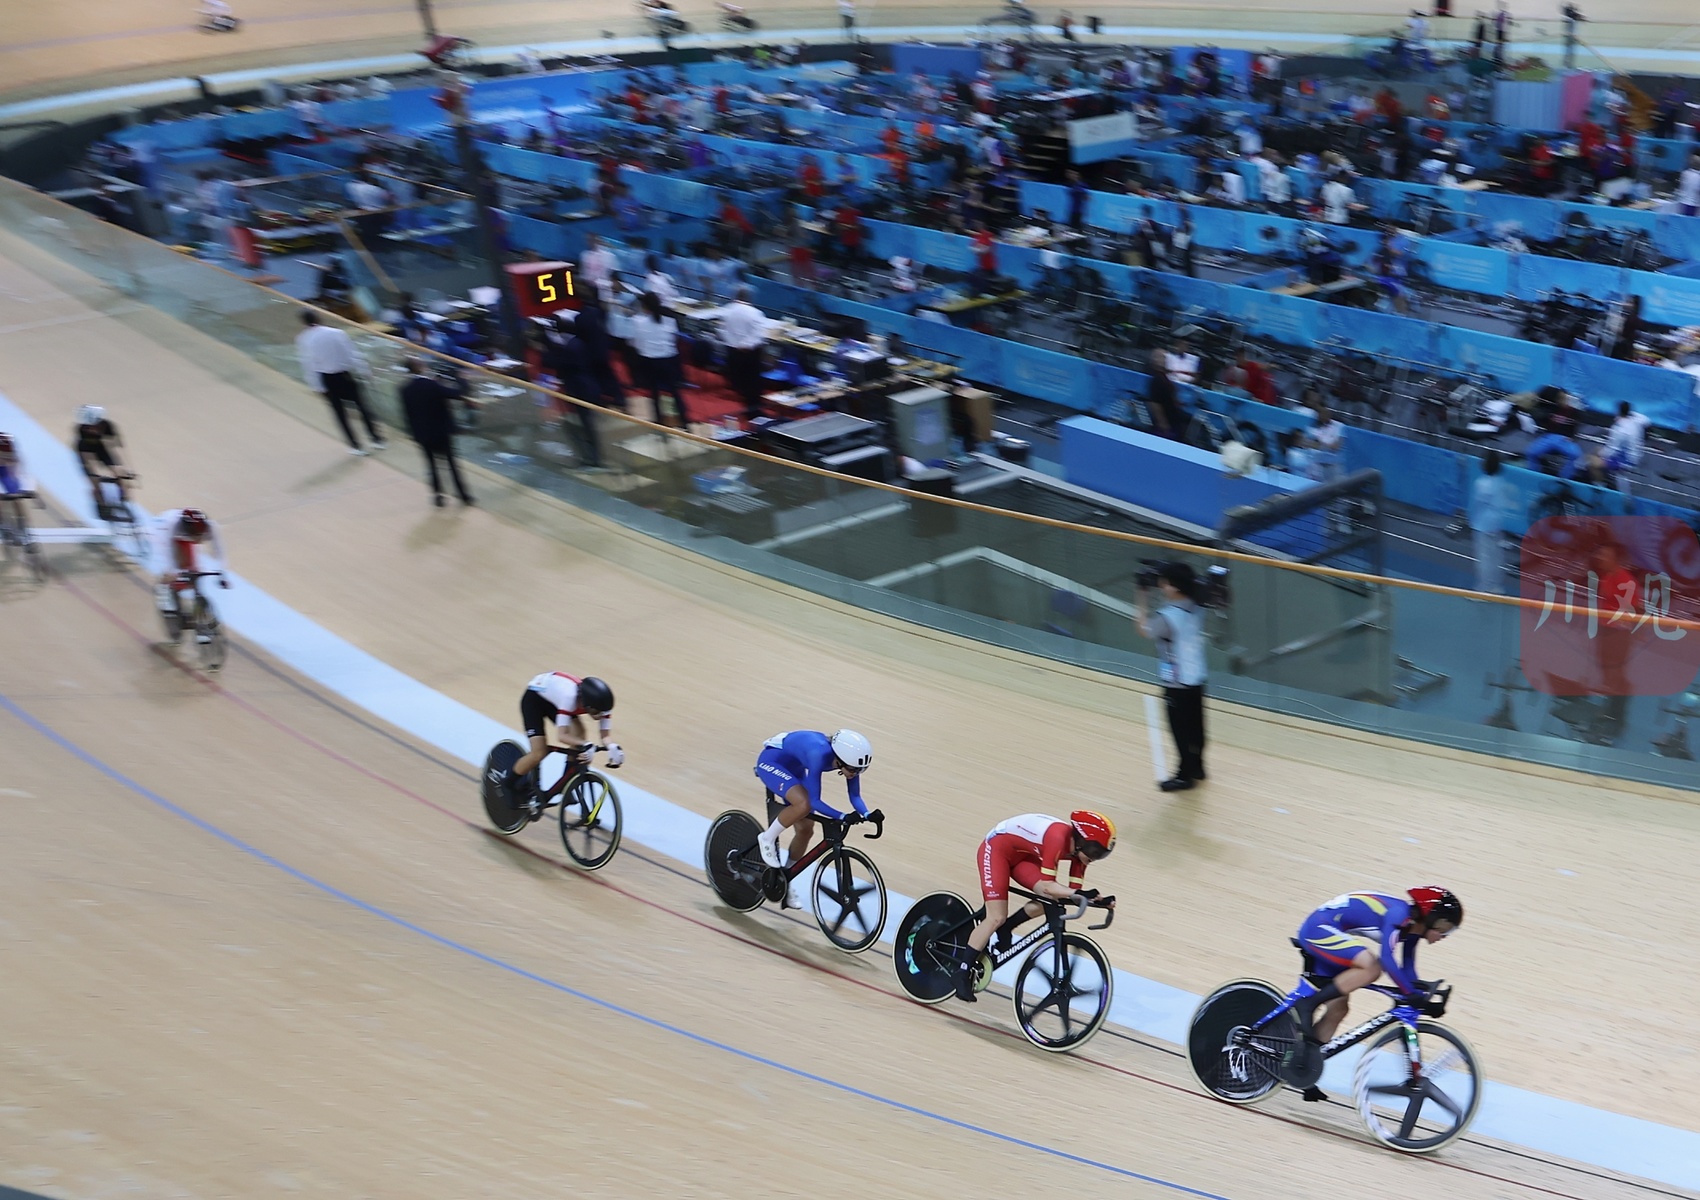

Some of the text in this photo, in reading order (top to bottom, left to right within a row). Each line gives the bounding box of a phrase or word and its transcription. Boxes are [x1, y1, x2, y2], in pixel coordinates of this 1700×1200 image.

[537, 270, 574, 303] 51
[759, 762, 792, 781] LIAO NING
[983, 842, 993, 888] SICHUAN
[996, 922, 1050, 964] BRIDGESTONE
